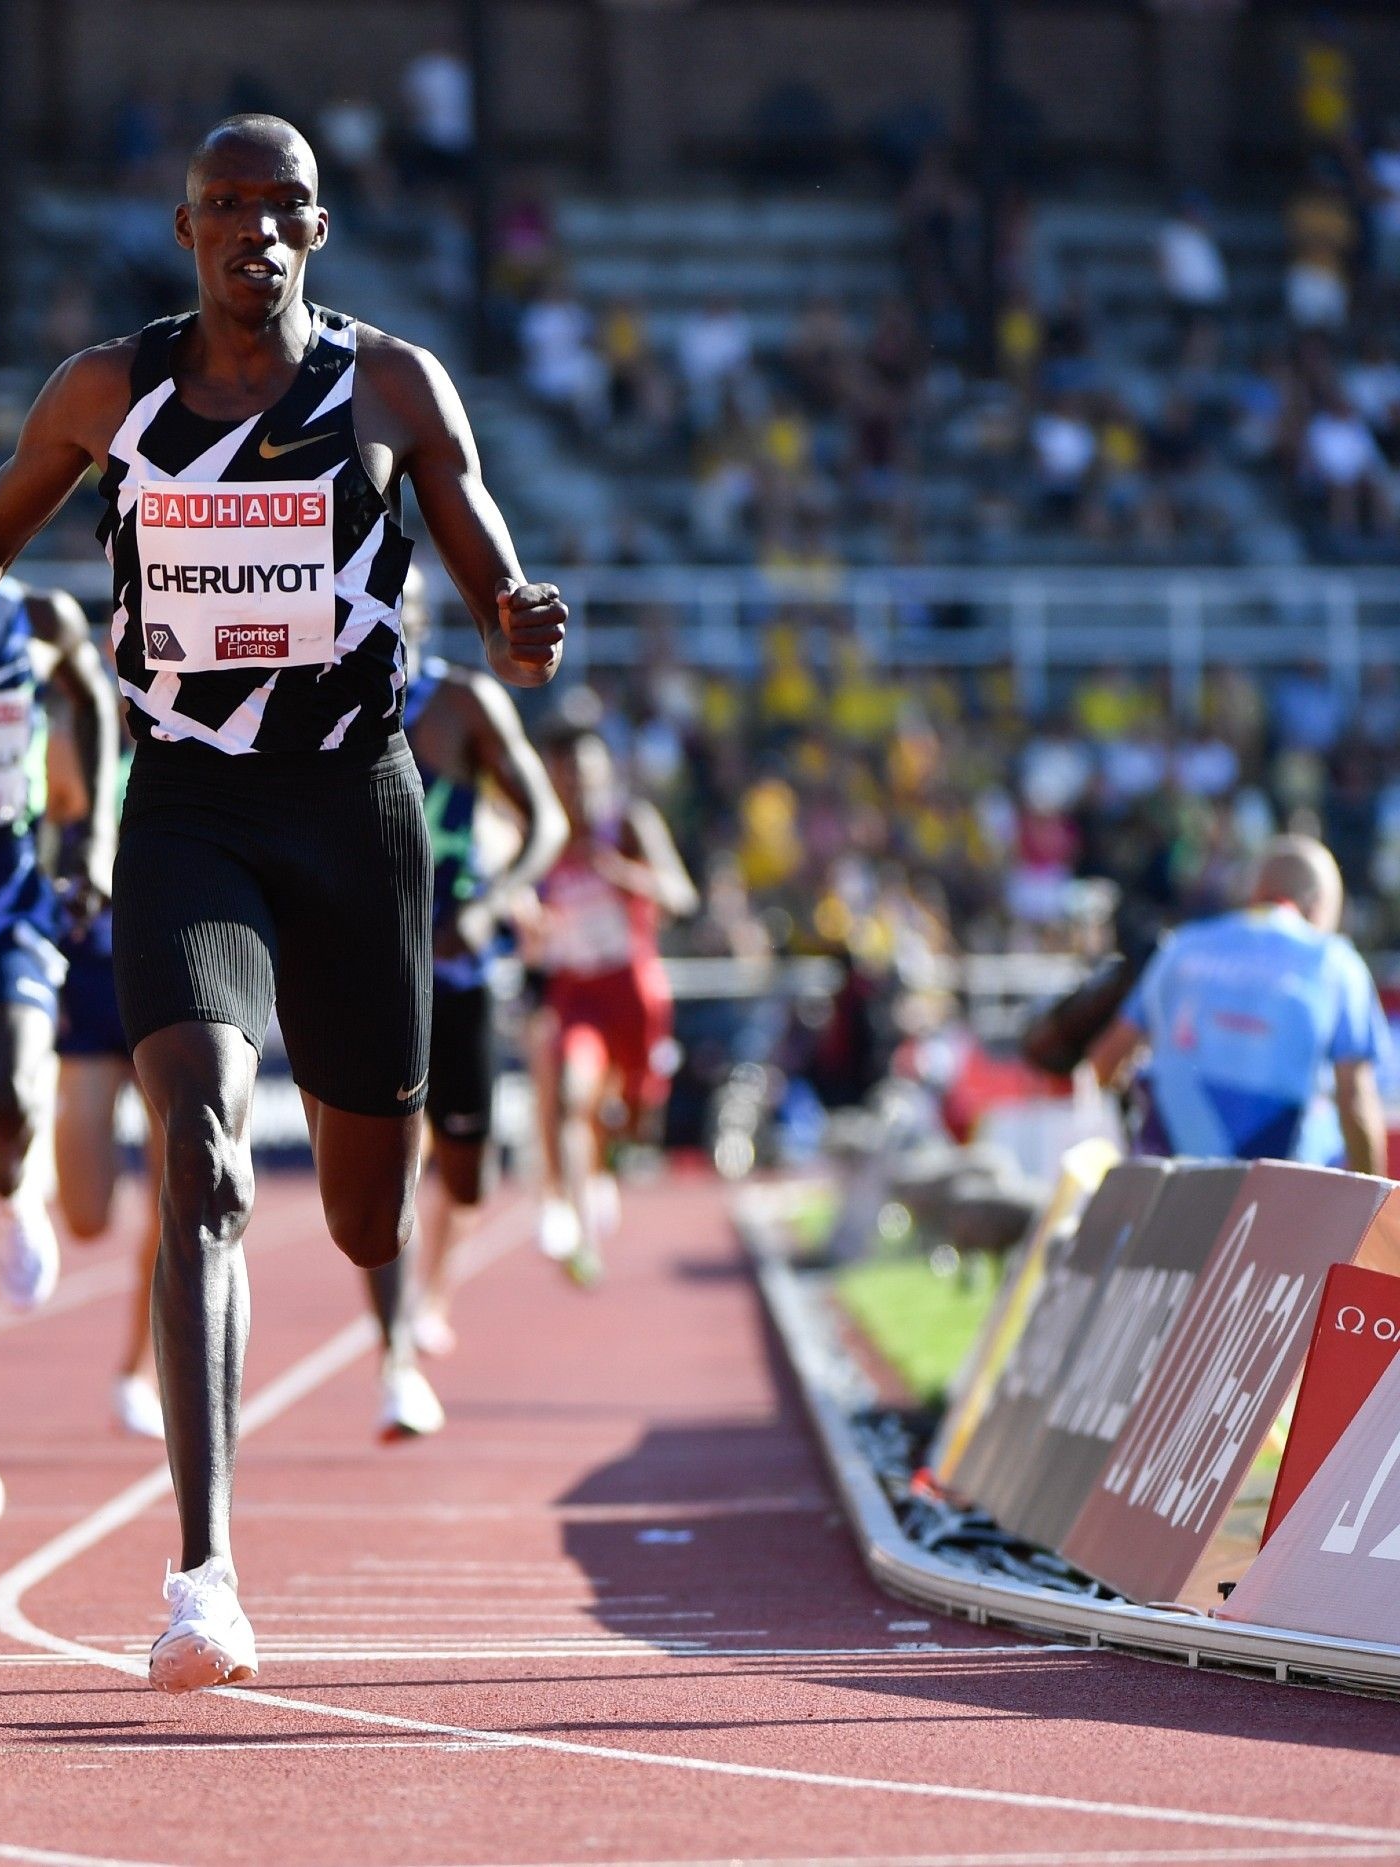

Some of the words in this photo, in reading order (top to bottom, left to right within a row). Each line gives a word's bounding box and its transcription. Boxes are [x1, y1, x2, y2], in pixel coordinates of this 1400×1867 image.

[143, 495, 323, 525] BAUHAUS
[147, 563, 324, 594] CHERUIYOT
[217, 628, 286, 643] Prioritet
[226, 642, 277, 657] Finans
[1128, 1262, 1323, 1534] OMEGA
